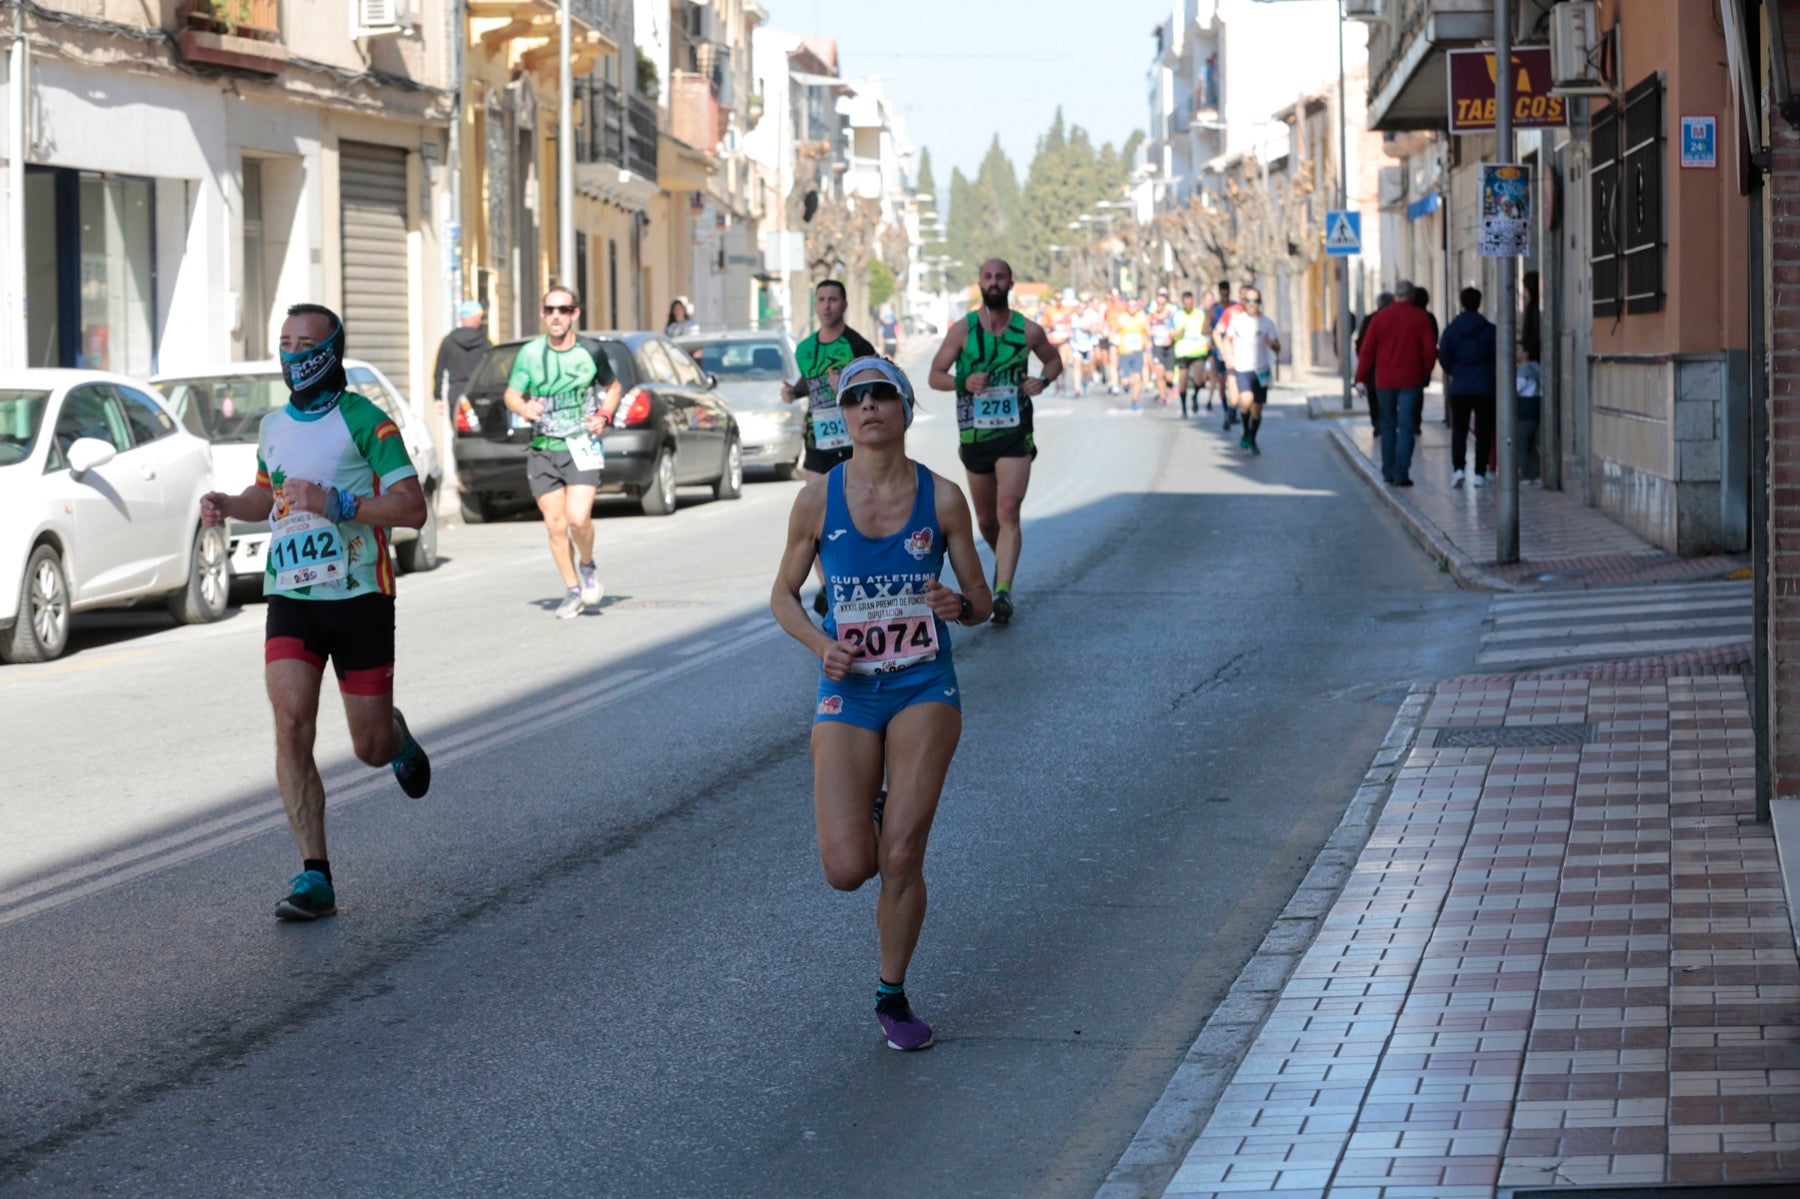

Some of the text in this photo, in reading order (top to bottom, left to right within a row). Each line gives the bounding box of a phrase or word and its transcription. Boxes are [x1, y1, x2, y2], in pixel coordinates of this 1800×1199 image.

[1456, 95, 1563, 121] TABCOS
[982, 399, 1012, 415] 278
[275, 531, 338, 567] 1142
[831, 572, 935, 584] CLUB ATLETISMO
[858, 599, 875, 612] GRAN
[876, 597, 899, 609] PREMIO
[900, 596, 908, 606] DE
[908, 594, 926, 605] FONDO
[844, 621, 932, 658] 2074
